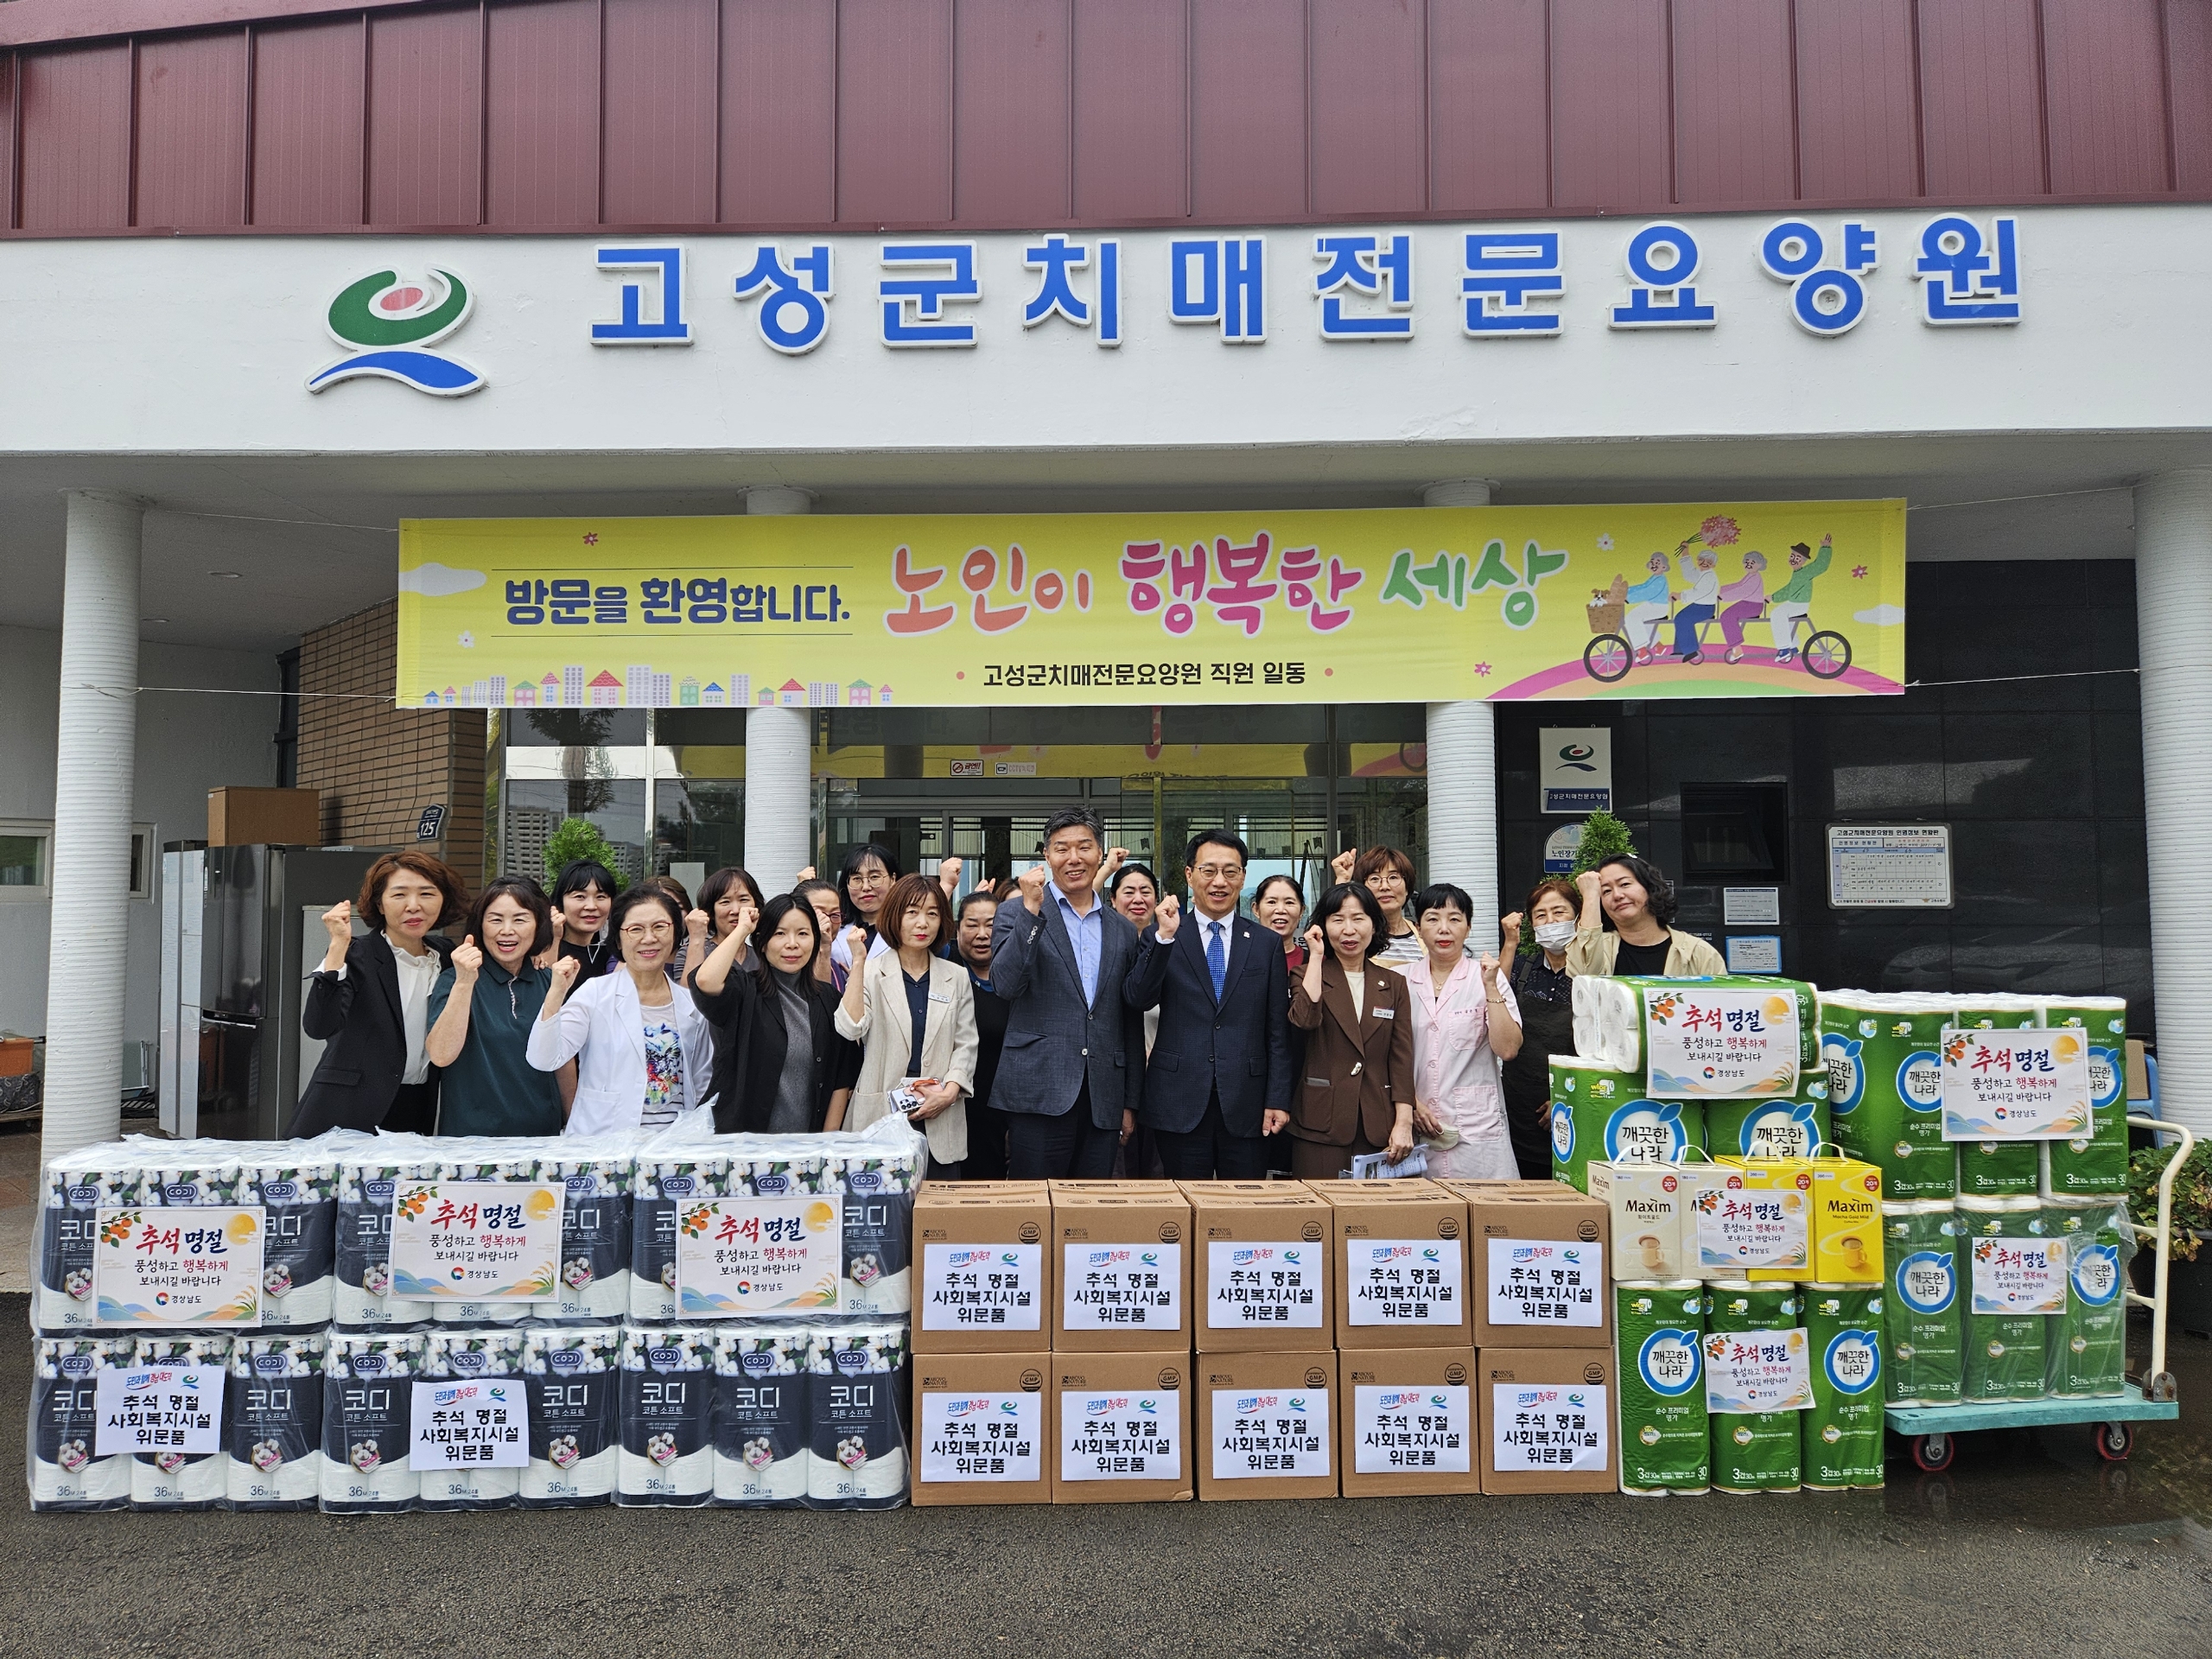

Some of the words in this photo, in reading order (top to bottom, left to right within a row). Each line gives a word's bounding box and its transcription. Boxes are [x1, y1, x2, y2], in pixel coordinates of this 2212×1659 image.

[590, 214, 2021, 354] 고성군치매전문요양원
[505, 579, 627, 625] 방문을
[640, 577, 850, 624] 환영합니다.
[885, 544, 1092, 636] 노인이
[1121, 531, 1363, 637] 행복한
[1381, 540, 1567, 628] 세상
[983, 663, 1202, 687] 고성군치매전문요양원
[1210, 662, 1255, 685] 직원
[1262, 662, 1306, 684] 일동
[421, 822, 436, 836] 125
[1682, 1004, 1722, 1033] 추석
[1726, 1009, 1764, 1032] 명절
[1682, 1037, 1722, 1049] 풍성하고
[1727, 1037, 1766, 1049] 행복하게
[1688, 1052, 1722, 1062] 보내시길
[1726, 1052, 1761, 1062] 바랍니다
[1970, 1047, 2011, 1071] 추석
[2015, 1050, 2055, 1072] 명절
[1971, 1078, 2012, 1090] 풍성하고
[2016, 1078, 2057, 1090] 행복하게
[1978, 1092, 2013, 1103] 보내시길
[2016, 1092, 2051, 1102] 바랍니다
[1592, 1175, 1610, 1190] Maxim
[1626, 1198, 1670, 1212] Maxim
[1722, 1199, 1751, 1221] 추석
[1755, 1204, 1783, 1220] 명절
[1827, 1198, 1873, 1211] Maxim
[432, 1199, 478, 1230] 추석
[483, 1205, 525, 1229] 명절
[715, 1215, 759, 1245] 추석
[764, 1217, 805, 1242] 명절
[1722, 1224, 1752, 1233] 풍성하고
[1756, 1224, 1784, 1233] 행복하게
[137, 1224, 180, 1255] 추석
[185, 1229, 227, 1254] 명절
[429, 1234, 474, 1248] 풍성하고
[480, 1235, 525, 1248] 행복하게
[435, 1251, 474, 1262] 보내시길
[478, 1251, 518, 1262] 바랍니다
[715, 1249, 759, 1263] 풍성하고
[763, 1248, 806, 1261] 행복하게
[1994, 1249, 2020, 1268] 추석
[2024, 1252, 2047, 1268] 명절
[135, 1259, 178, 1273] 풍성하고
[183, 1259, 228, 1273] 행복하게
[720, 1265, 758, 1275] 보내시길
[762, 1263, 801, 1274] 바랍니다
[140, 1276, 177, 1287] 보내시길
[181, 1276, 221, 1287] 바랍니다
[946, 1273, 976, 1288] 추석
[988, 1274, 1018, 1289] 명절
[1086, 1273, 1116, 1287] 추석
[1128, 1274, 1158, 1288] 명절
[1230, 1270, 1260, 1286] 추석
[1272, 1272, 1300, 1287] 명절
[1370, 1268, 1399, 1283] 추석
[1411, 1269, 1440, 1284] 명절
[1510, 1268, 1540, 1283] 추석
[1552, 1270, 1580, 1285] 명절
[1993, 1271, 2020, 1281] 풍성하고
[2023, 1271, 2048, 1281] 행복하게
[753, 1283, 783, 1292] 경상남도
[1217, 1287, 1313, 1303] 사회복지시설
[1358, 1285, 1452, 1301] 사회복지시설
[1498, 1285, 1592, 1302] 사회복지시설
[933, 1290, 1030, 1306] 사회복지시설
[1074, 1290, 1170, 1306] 사회복지시설
[957, 1307, 1005, 1323] 위문품
[1098, 1307, 1145, 1322] 위문품
[1243, 1306, 1288, 1320] 위문품
[1382, 1303, 1428, 1318] 위문품
[1522, 1302, 1567, 1319] 위문품
[1652, 1351, 1688, 1364] 깨끗한
[1731, 1344, 1758, 1364] 추석
[1762, 1344, 1789, 1362] 명절
[1837, 1351, 1869, 1364] 깨끗한
[1660, 1365, 1683, 1378] 나라
[1763, 1366, 1791, 1375] 행복하게
[641, 1382, 685, 1404] 코디
[123, 1395, 158, 1412] 추석
[169, 1395, 200, 1412] 명절
[642, 1407, 658, 1415] 코튼
[660, 1406, 683, 1414] 소프트
[108, 1413, 211, 1429] 사회복지시설
[433, 1411, 463, 1427] 추석
[476, 1409, 506, 1425] 명절
[1377, 1414, 1407, 1430] 추석
[1419, 1416, 1447, 1431] 명절
[1516, 1413, 1545, 1428] 추석
[1556, 1414, 1585, 1429] 명절
[944, 1422, 976, 1438] 추석
[988, 1423, 1017, 1439] 명절
[1084, 1421, 1115, 1437] 추석
[1127, 1421, 1156, 1437] 명절
[1235, 1419, 1265, 1434] 추석
[1277, 1420, 1306, 1434] 명절
[137, 1429, 184, 1445] 위문품
[421, 1427, 518, 1444] 사회복지시설
[1365, 1433, 1459, 1448] 사회복지시설
[1503, 1431, 1597, 1446] 사회복지시설
[931, 1440, 1030, 1456] 사회복지시설
[1071, 1439, 1169, 1454] 사회복지시설
[1223, 1437, 1319, 1452] 사회복지시설
[446, 1445, 493, 1461] 위문품
[1389, 1451, 1435, 1465] 위문품
[1528, 1448, 1573, 1463] 위문품
[957, 1459, 1004, 1473] 위문품
[1096, 1457, 1144, 1472] 위문품
[1248, 1455, 1294, 1470] 위문품
